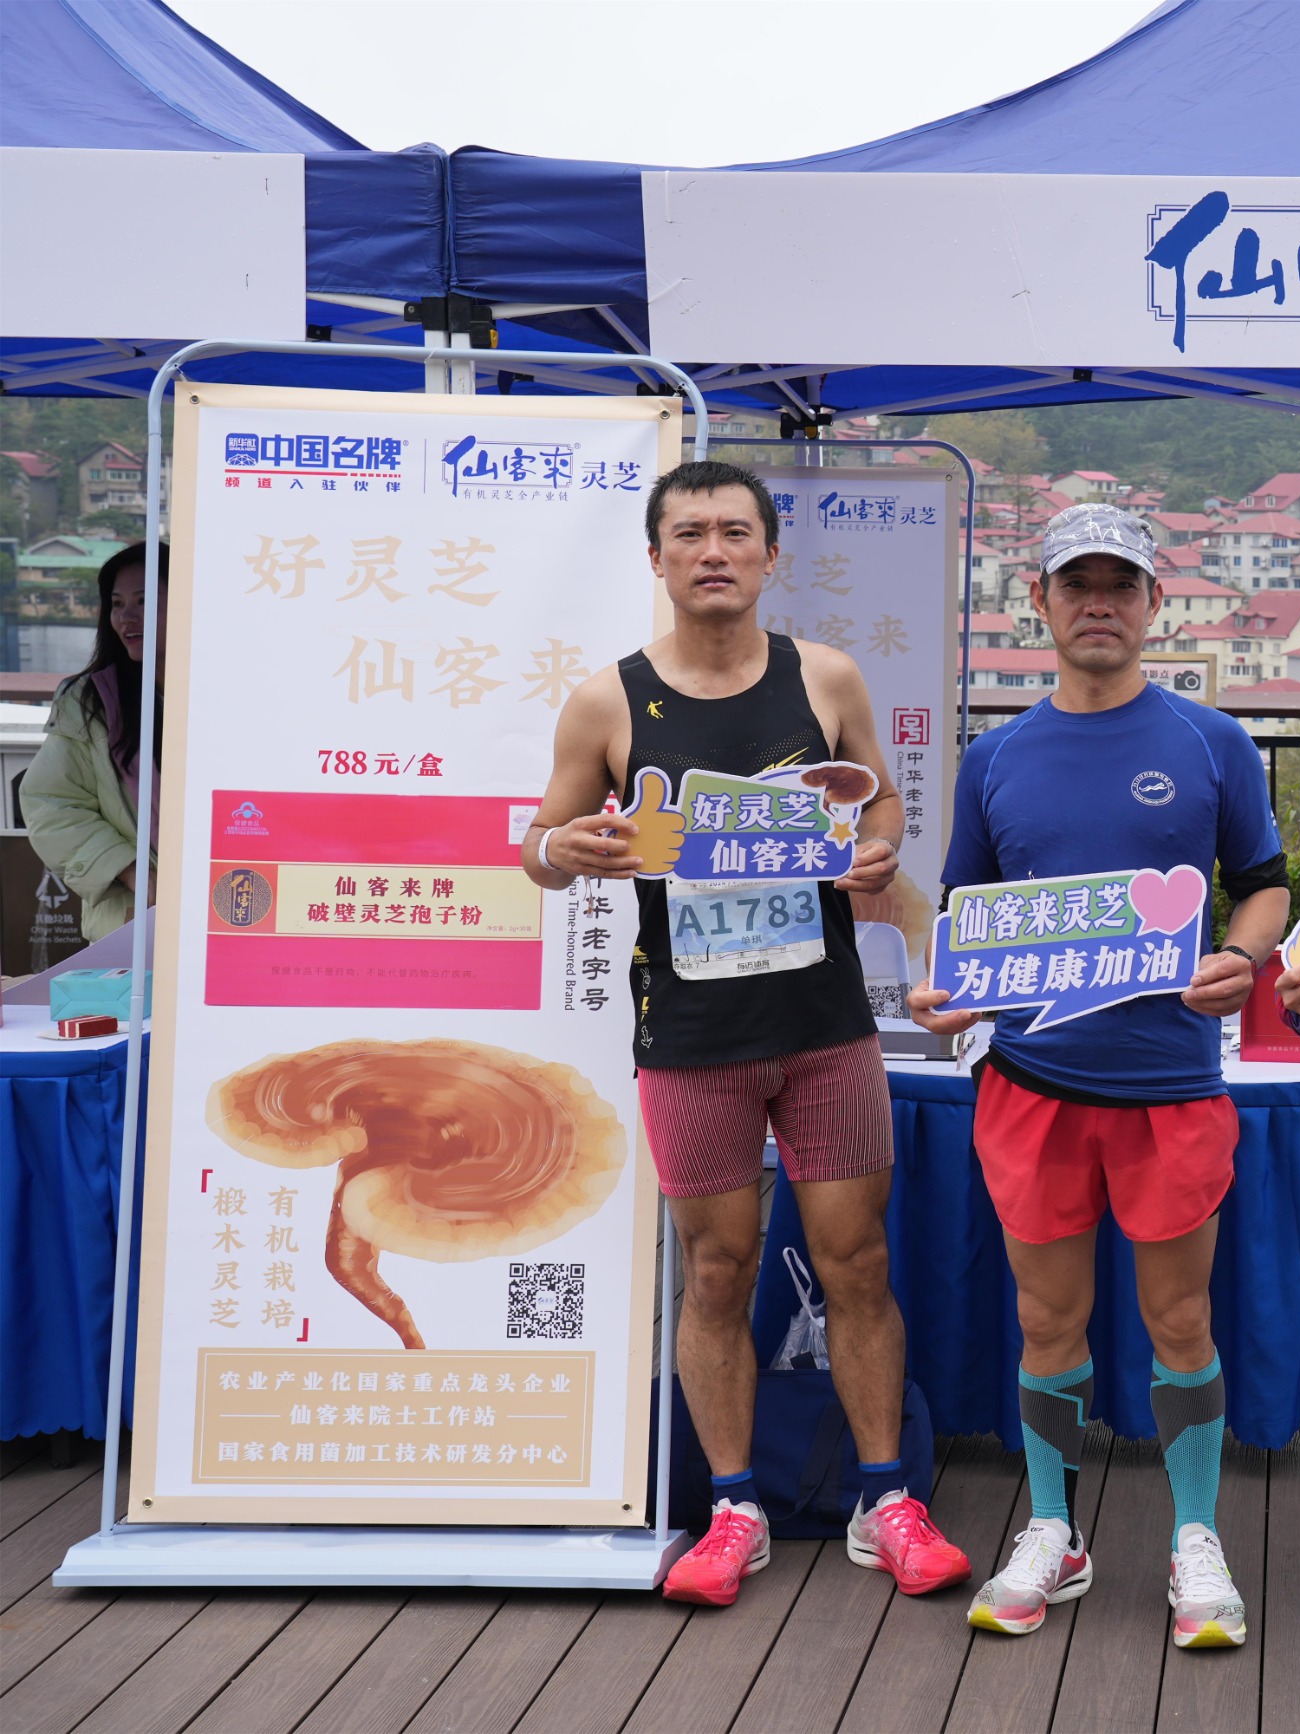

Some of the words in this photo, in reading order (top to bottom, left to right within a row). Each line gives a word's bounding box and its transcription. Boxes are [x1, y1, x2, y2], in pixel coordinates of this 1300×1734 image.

[261, 434, 402, 471] 中国名牌
[225, 476, 401, 493] 频道入驻伙伴
[462, 487, 570, 502] 有机灵芝全产业链
[242, 533, 502, 607] 好灵芝
[331, 634, 594, 711] 仙客来
[690, 792, 818, 831] 好灵芝
[905, 751, 925, 839] 中华老字号
[708, 837, 830, 874] 仙客来
[335, 876, 455, 899] 仙客来牌
[307, 901, 484, 926] 破壁灵芝孢子粉
[675, 890, 816, 938] A1783
[955, 881, 1128, 946] 仙客来灵芝
[949, 938, 1183, 1002] 为健康加油
[564, 980, 577, 1011] Brand
[208, 1186, 249, 1330] 椴木灵芝
[260, 1184, 301, 1330] 有机栽培
[218, 1370, 572, 1394] 农业产业化国家重点龙头企业
[289, 1404, 497, 1427] 仙客来院士工作站
[218, 1441, 568, 1465] 国家食用菌加工技术研发分中心
